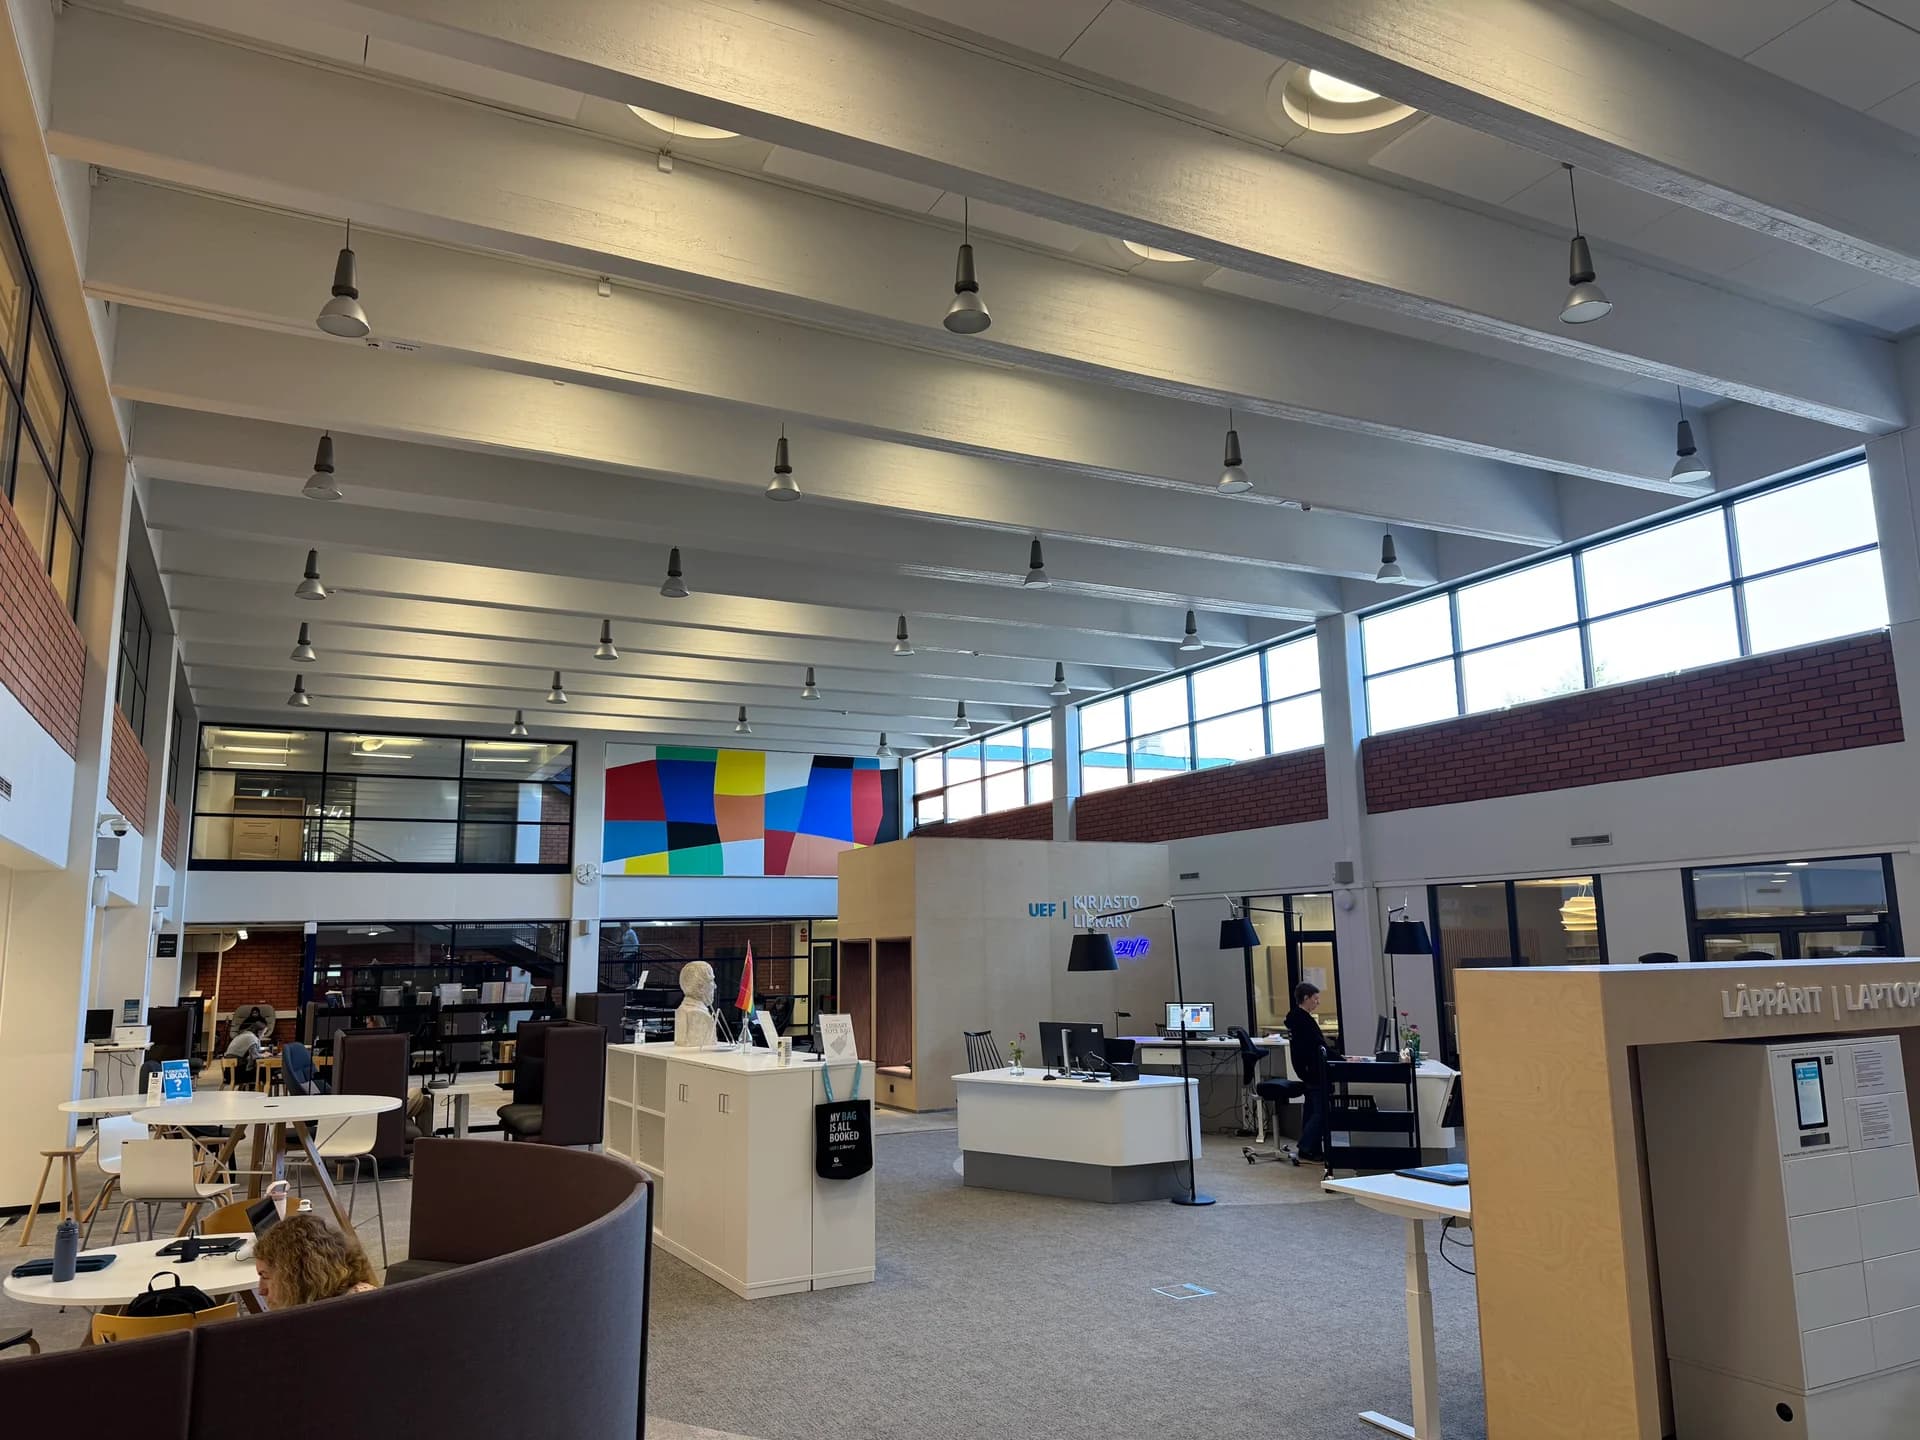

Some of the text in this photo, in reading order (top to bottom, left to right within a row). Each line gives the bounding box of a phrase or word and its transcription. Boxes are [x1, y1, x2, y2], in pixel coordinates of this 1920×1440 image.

[1028, 902, 1057, 917] UEF
[1073, 895, 1140, 912] KIRJASTO
[1115, 939, 1150, 957] 24/7
[1721, 982, 1920, 1018] LÄPPÄRIT LAPTOP
[830, 1110, 857, 1122] MY BAG
[830, 1121, 851, 1132] IS ALL
[829, 1131, 860, 1143] BOOKED
